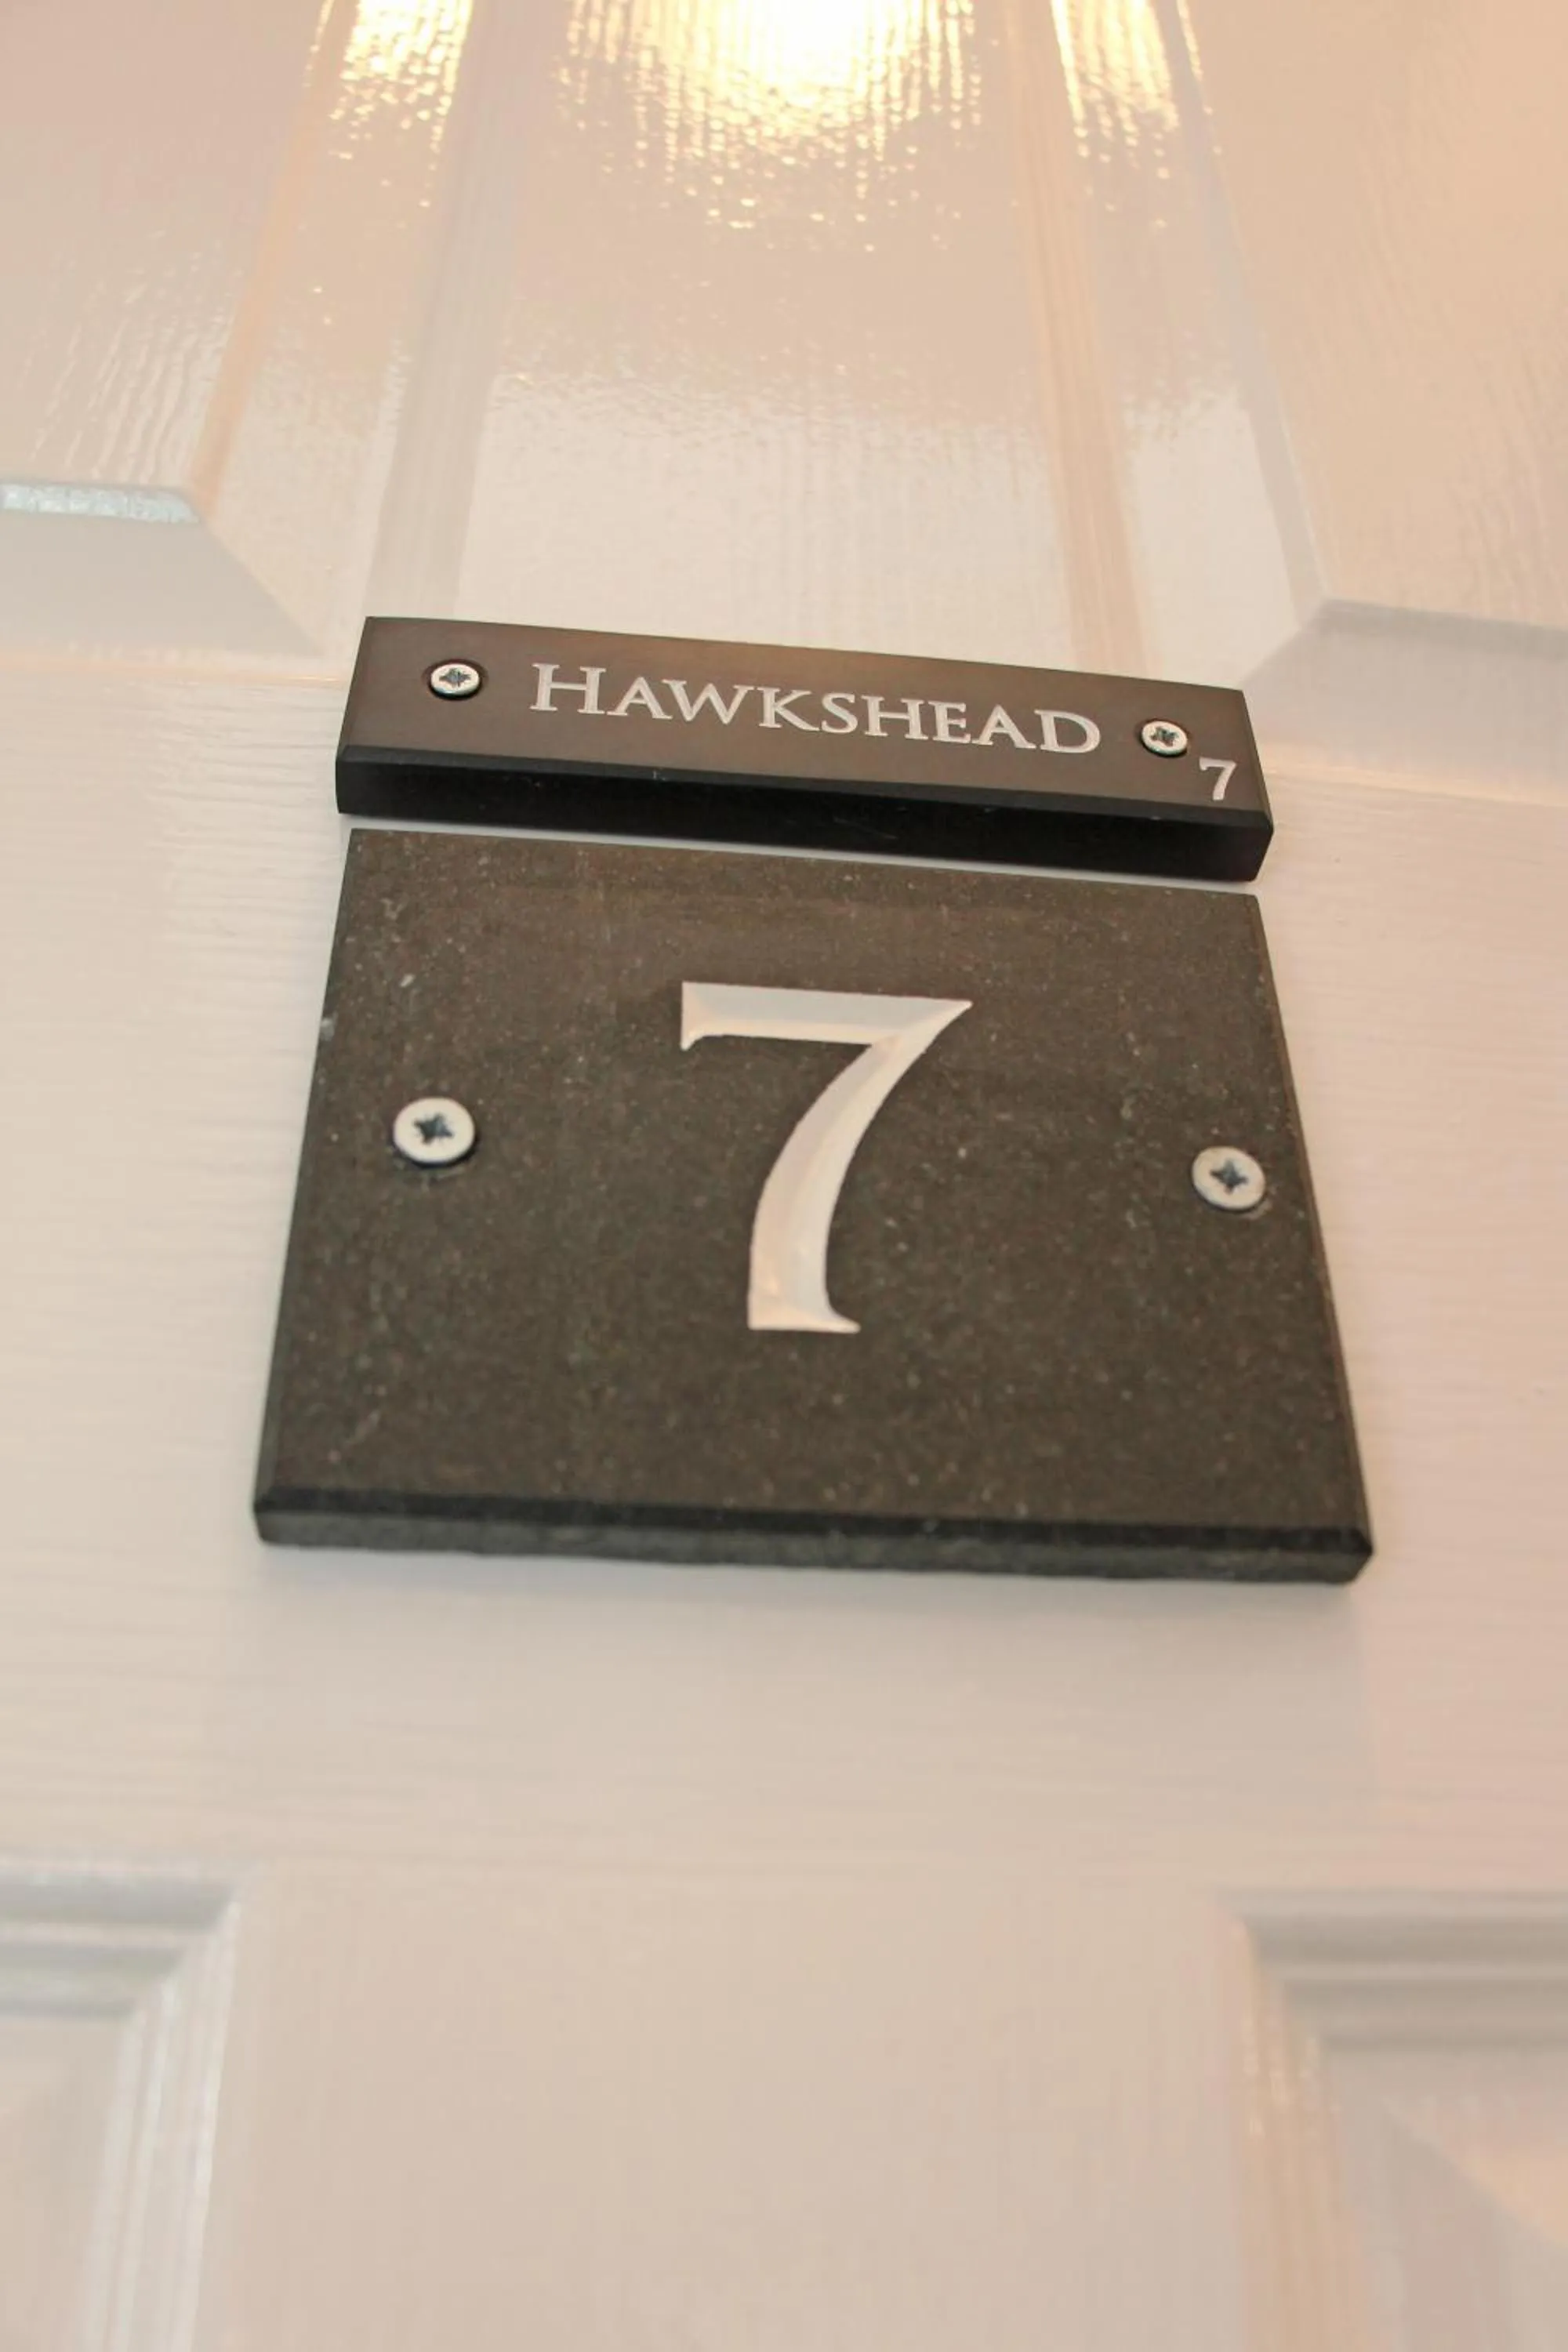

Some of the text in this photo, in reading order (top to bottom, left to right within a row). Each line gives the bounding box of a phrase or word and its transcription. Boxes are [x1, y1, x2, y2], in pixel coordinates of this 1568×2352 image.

[529, 662, 1101, 753] HAWKSHEAD
[1199, 757, 1236, 800] 7
[680, 981, 973, 1334] 7
